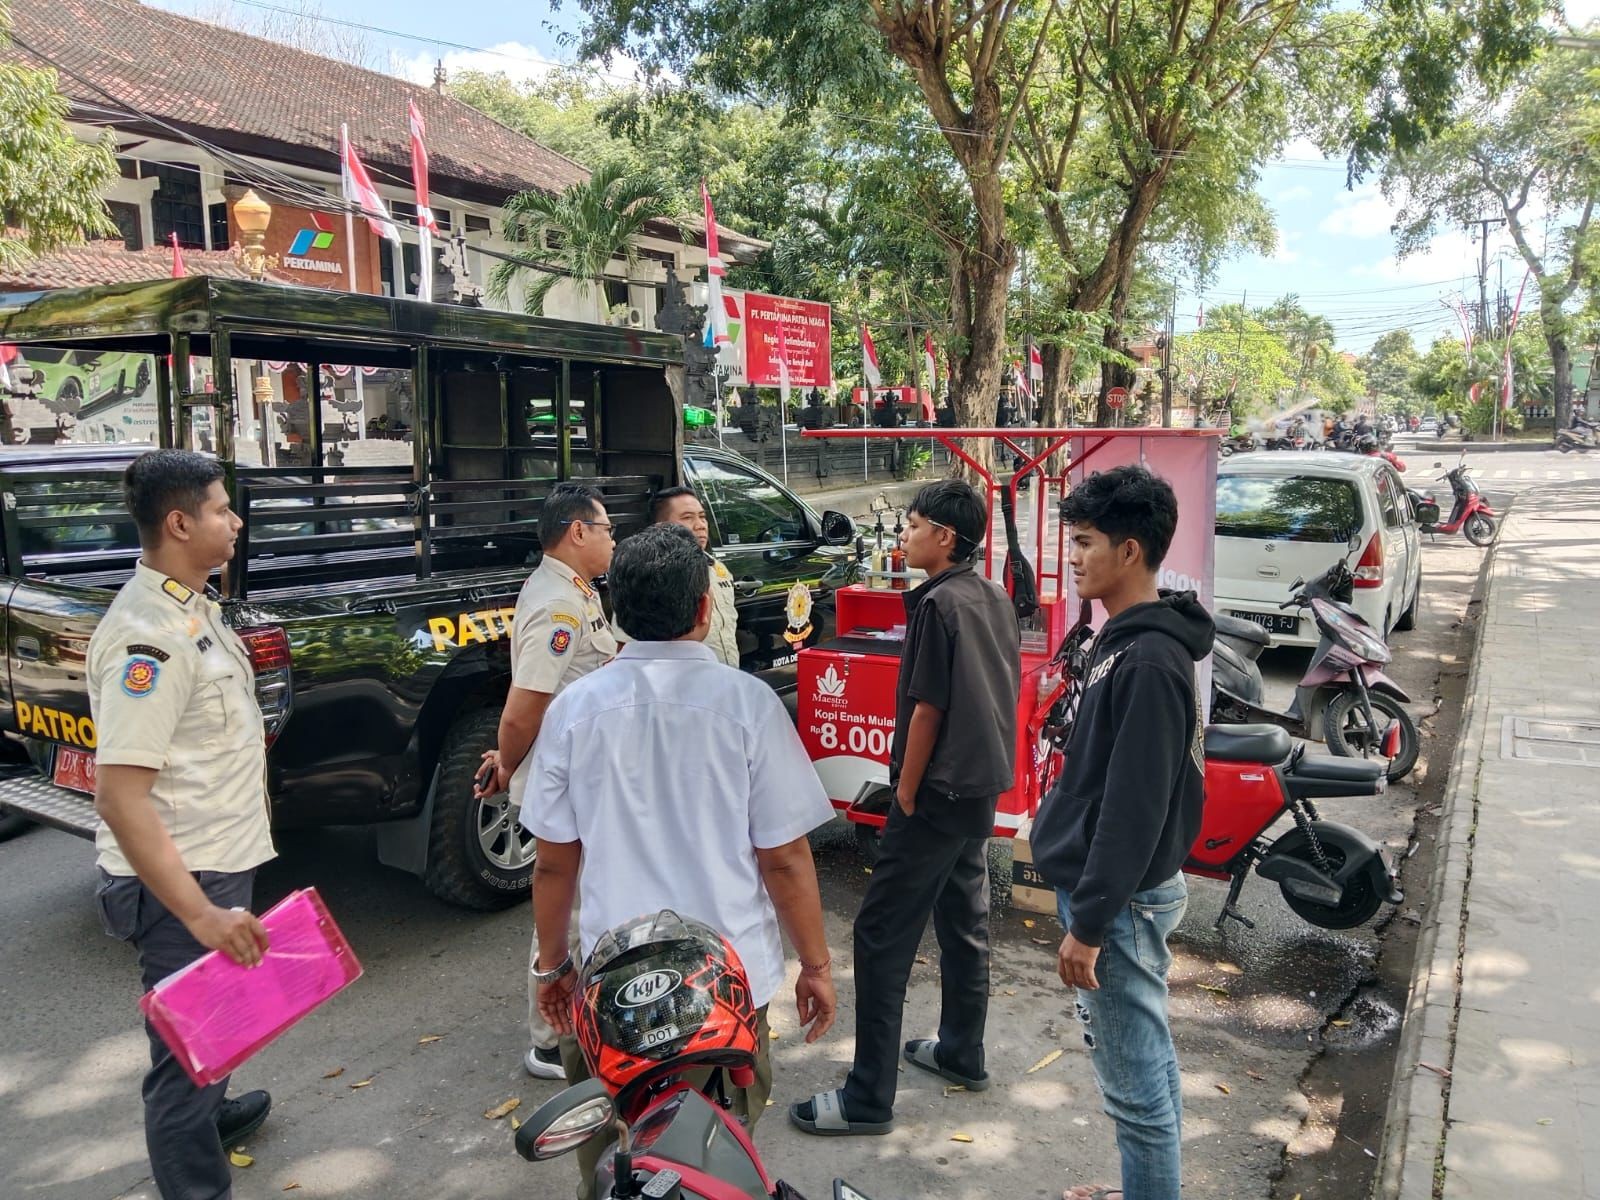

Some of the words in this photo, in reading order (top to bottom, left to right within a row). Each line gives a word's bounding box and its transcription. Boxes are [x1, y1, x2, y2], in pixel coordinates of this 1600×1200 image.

[283, 256, 343, 274] PERTAMINA
[760, 310, 792, 325] PERTAMINA
[791, 313, 809, 326] PATRA
[808, 315, 826, 328] NIAGA
[1108, 394, 1128, 403] STOP
[1250, 614, 1274, 627] 1073
[1280, 616, 1294, 629] FJ
[772, 656, 790, 668] KOTA
[790, 653, 798, 663] DE
[812, 693, 848, 705] Maestro
[16, 700, 97, 748] PATRO
[815, 708, 838, 721] Kopi
[839, 711, 866, 724] Enak
[867, 714, 896, 728] Mulai
[60, 751, 79, 772] DK
[647, 1026, 673, 1044] DOT
